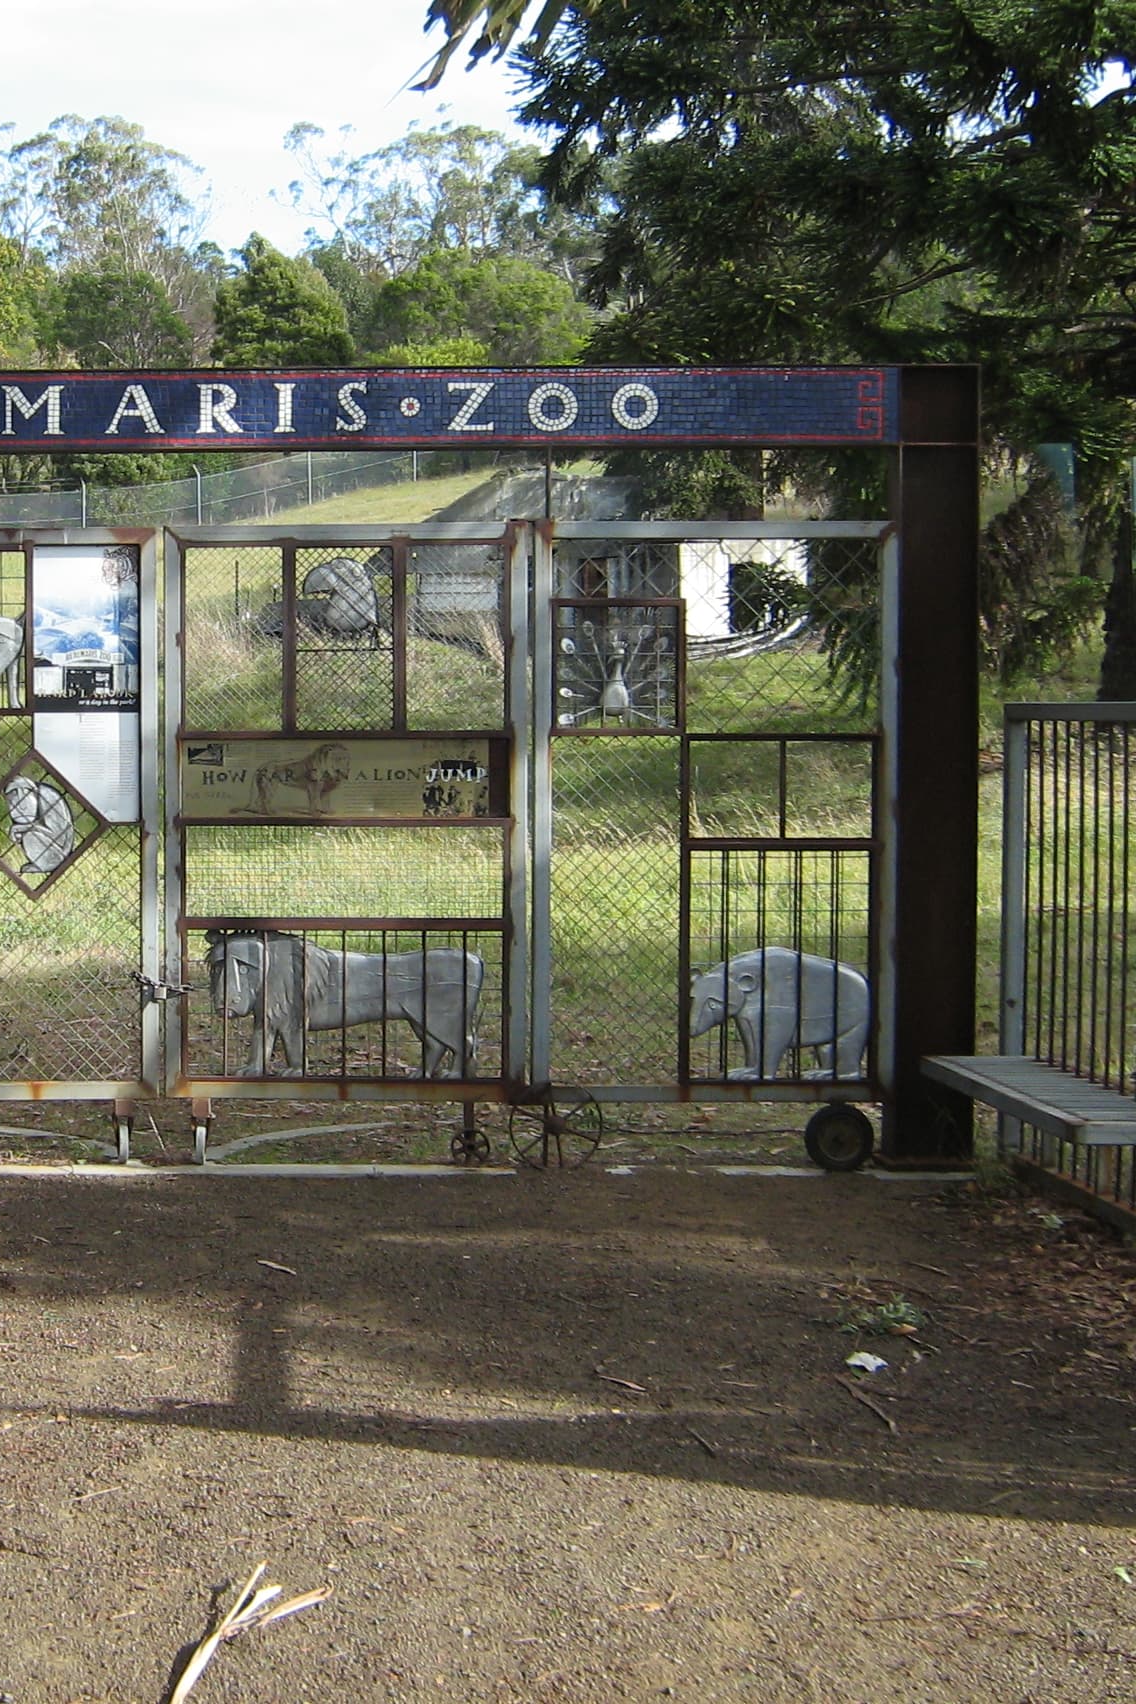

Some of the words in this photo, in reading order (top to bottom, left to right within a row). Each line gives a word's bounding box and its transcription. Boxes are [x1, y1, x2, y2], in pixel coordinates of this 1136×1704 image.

[446, 380, 661, 434] ZOO
[202, 769, 246, 785] HOW
[257, 768, 297, 783] FAR
[307, 768, 350, 783] CAN
[356, 769, 367, 781] A
[374, 768, 421, 781] LION
[425, 766, 487, 783] JUMP
